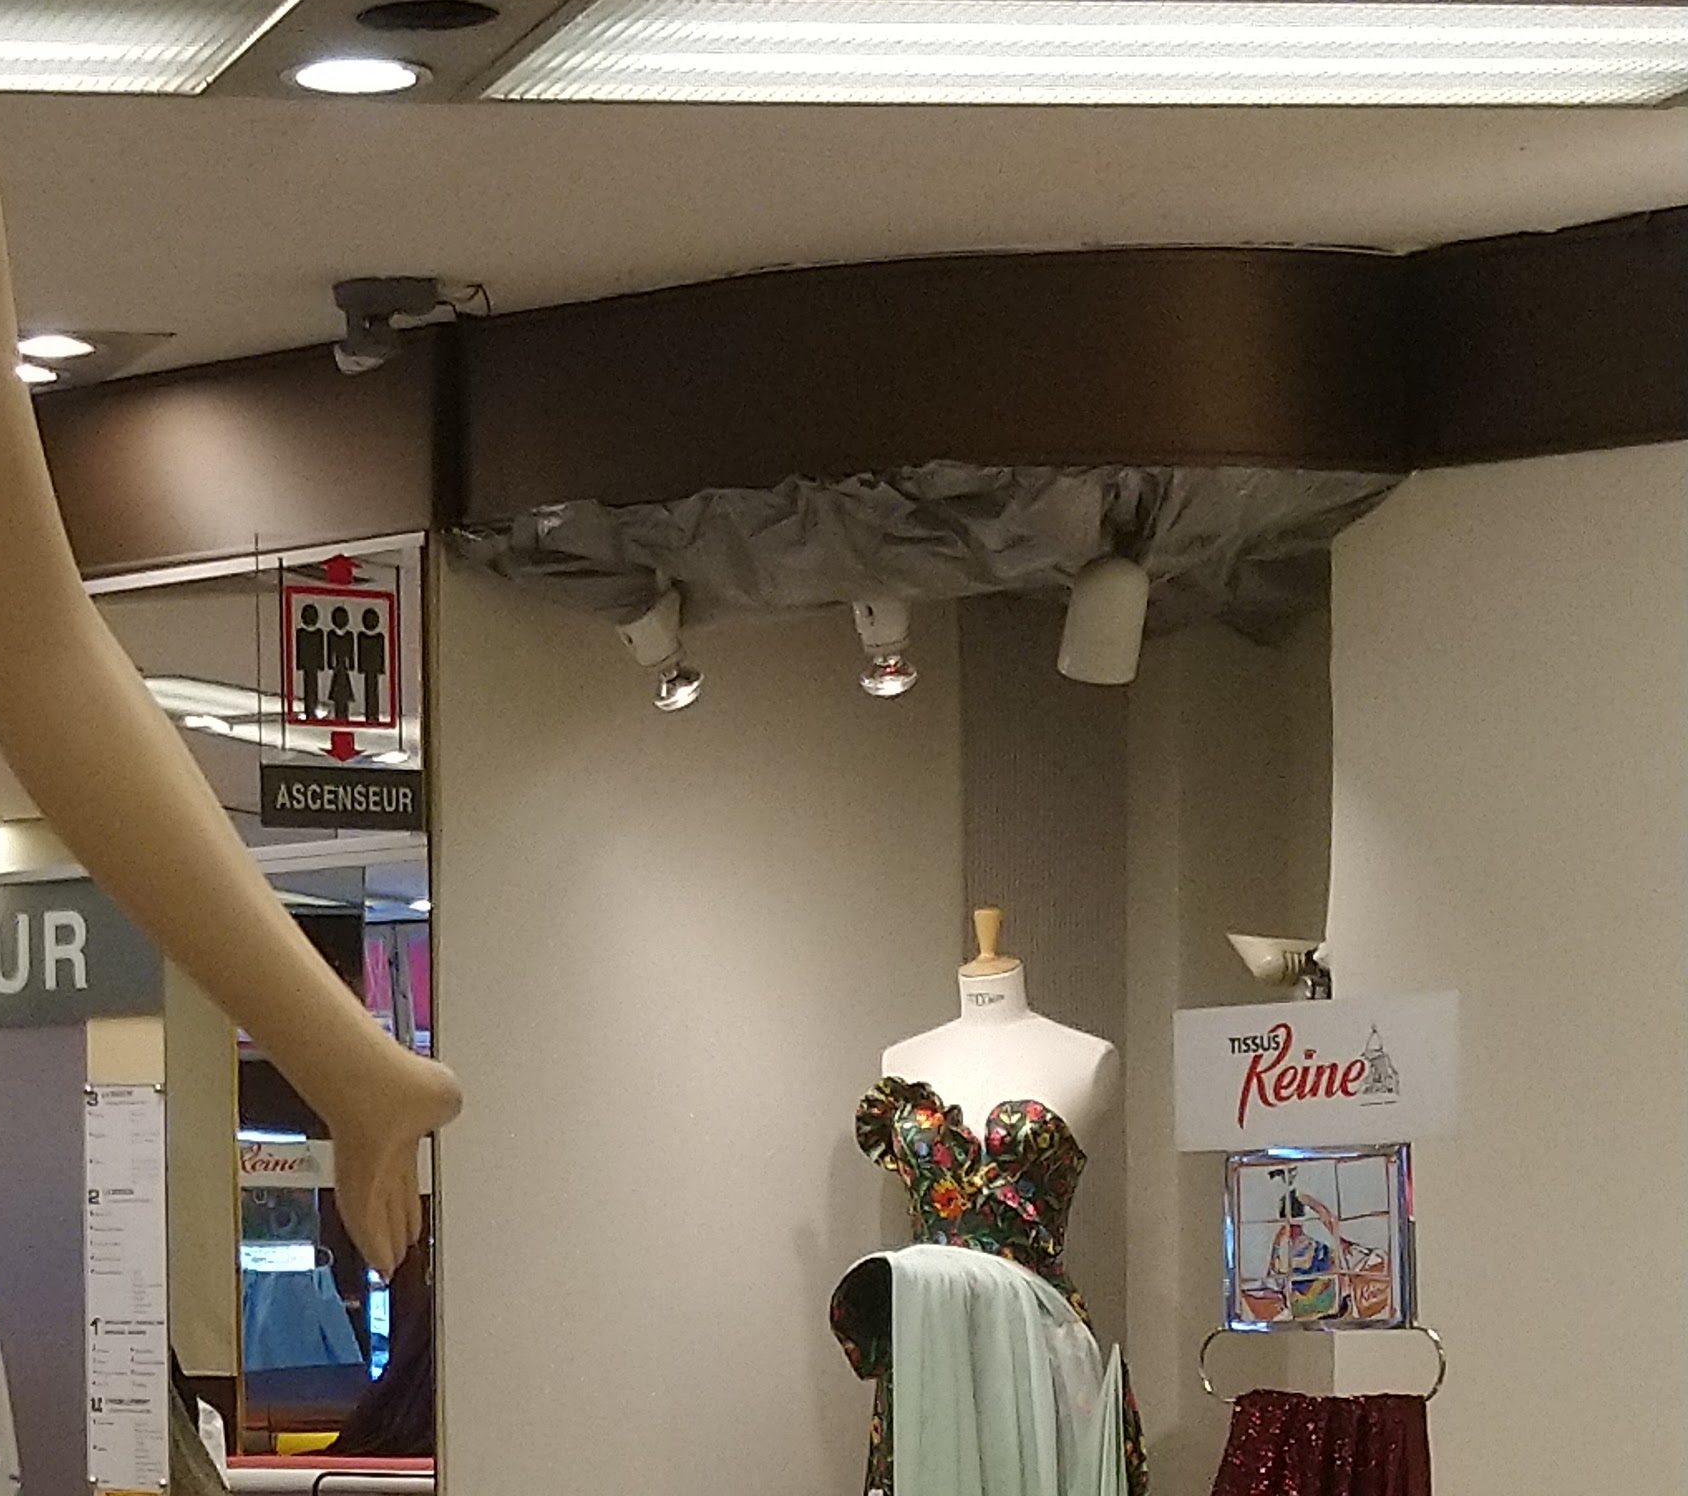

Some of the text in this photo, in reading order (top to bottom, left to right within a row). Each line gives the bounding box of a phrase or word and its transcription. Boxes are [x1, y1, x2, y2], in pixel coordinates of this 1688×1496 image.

[275, 782, 413, 814] ASCENSEUR
[1228, 1033, 1281, 1054] TISSUS
[1238, 1022, 1366, 1130] Reine
[88, 1189, 100, 1205] 2
